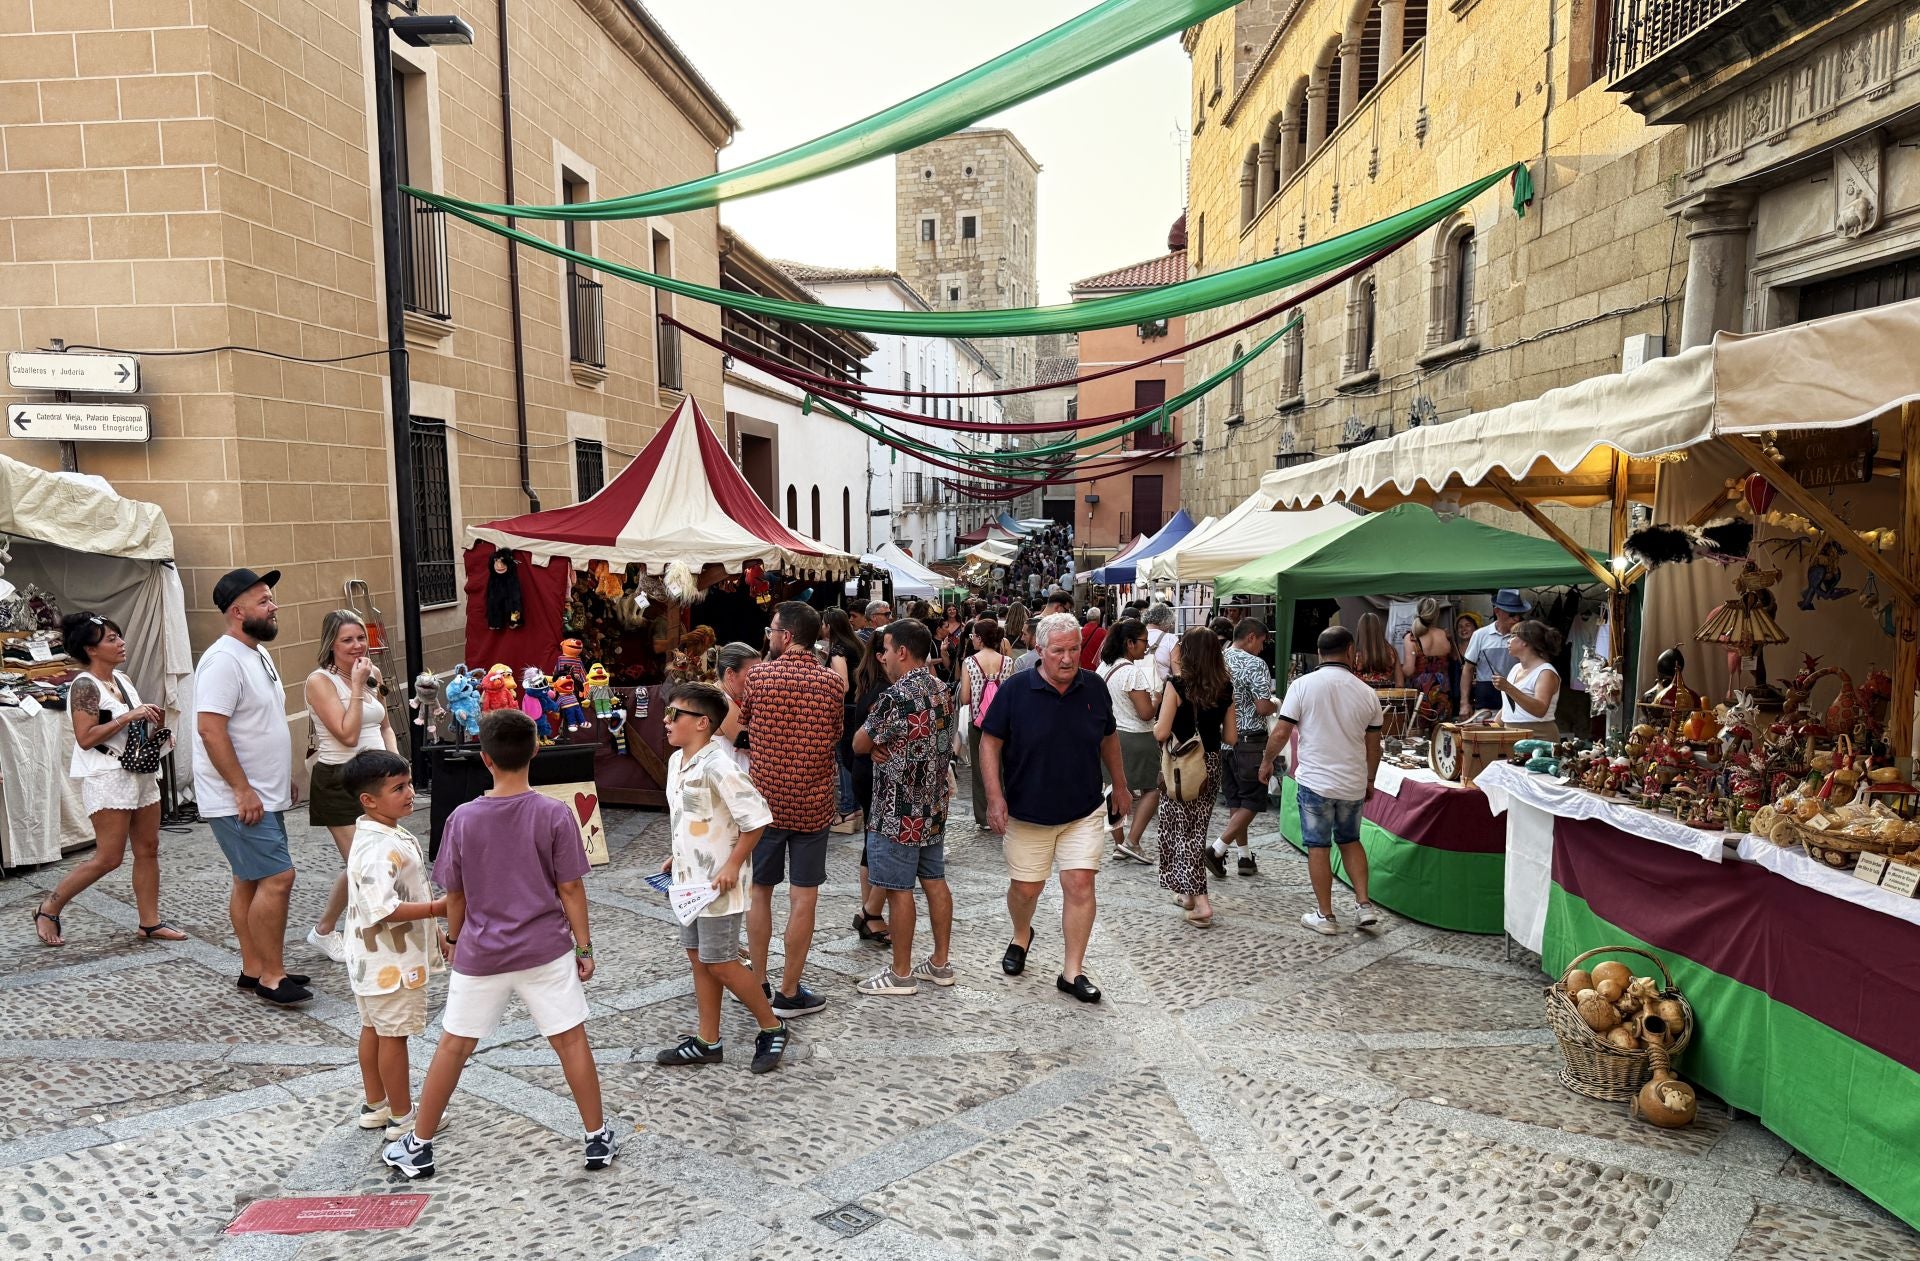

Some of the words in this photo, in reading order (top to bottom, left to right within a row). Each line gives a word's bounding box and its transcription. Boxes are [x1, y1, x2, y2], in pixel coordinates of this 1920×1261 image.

[12, 366, 47, 375] Caballeros
[51, 368, 56, 376] y
[36, 413, 62, 421] Catedral
[65, 413, 83, 422] Vieja,
[112, 414, 142, 423] Episcopal
[73, 423, 97, 431] Museo
[102, 423, 143, 432] Etnográfico
